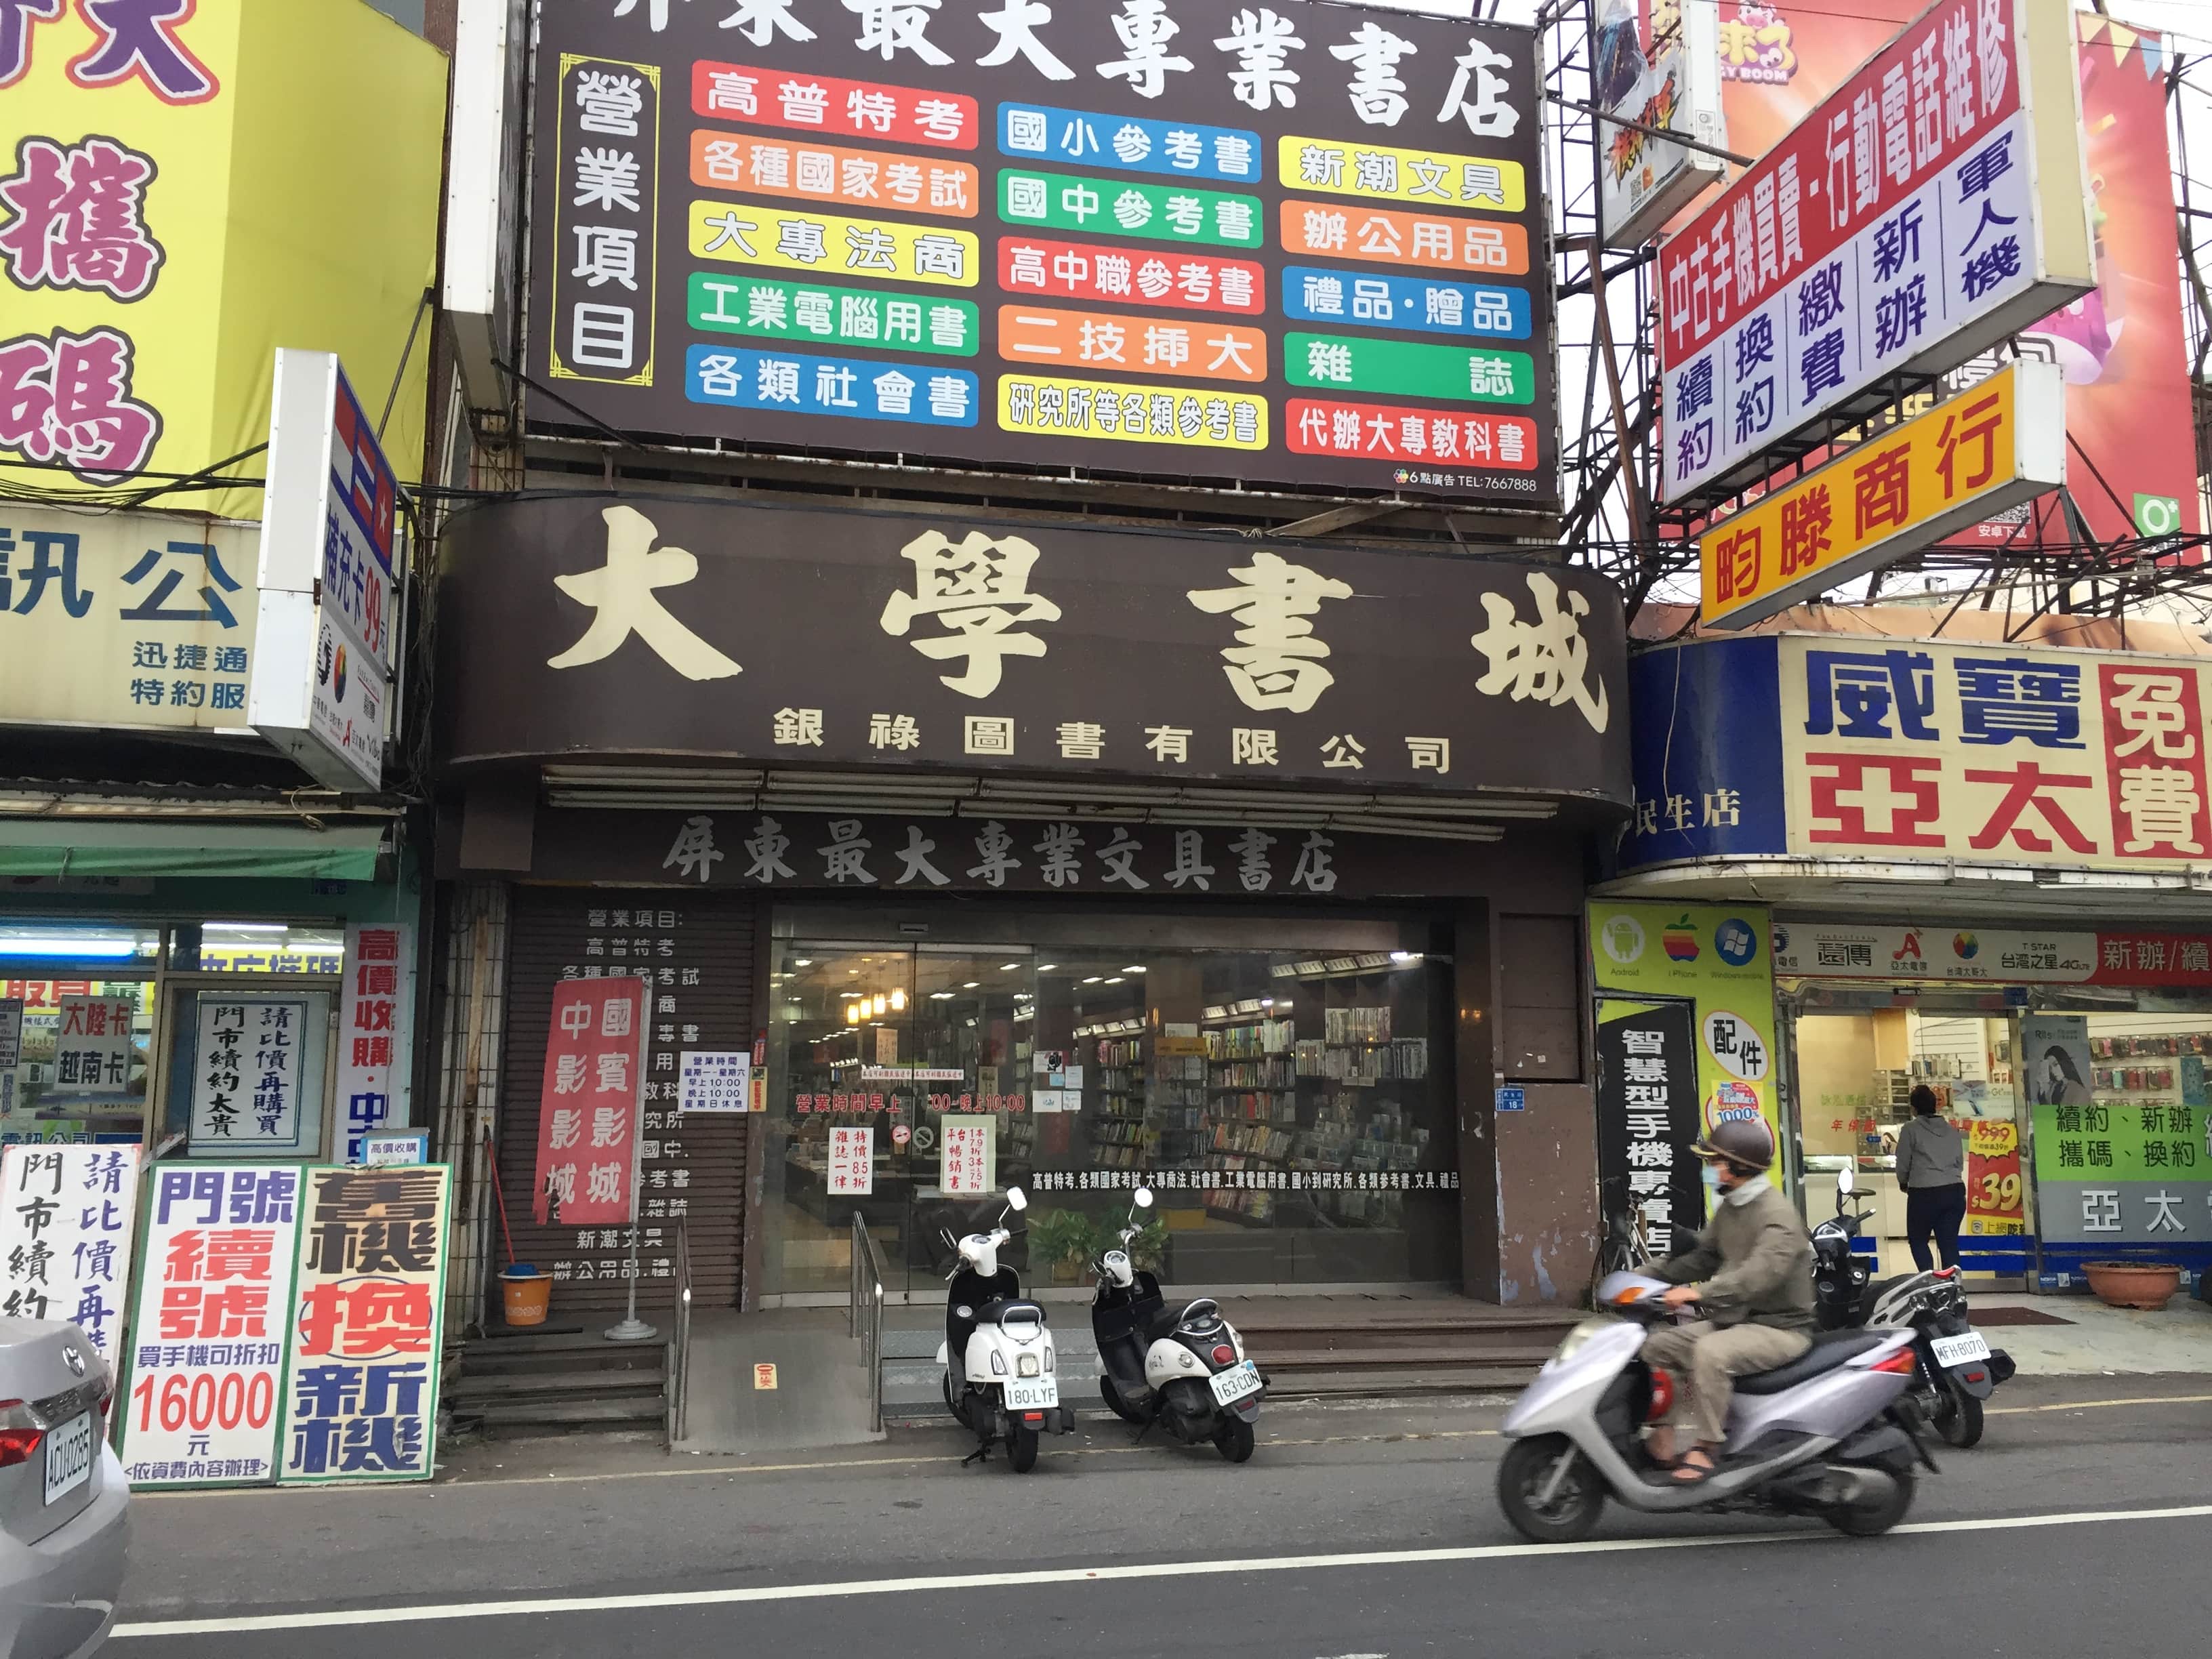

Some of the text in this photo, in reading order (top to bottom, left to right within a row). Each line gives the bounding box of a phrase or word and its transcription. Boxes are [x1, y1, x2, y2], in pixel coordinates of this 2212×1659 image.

[708, 70, 964, 141] 高普特考
[1740, 68, 1789, 82] BOOM
[1007, 109, 1253, 175] 國小參考書
[703, 140, 968, 211] 各種國家考試
[1299, 145, 1505, 204] 新潮文具
[571, 69, 643, 370] 營業項目
[1007, 178, 1254, 241] 國中參考書
[1303, 210, 1509, 268] 辦公用品
[1957, 129, 2022, 302] 軍人機
[703, 211, 965, 279] 大專法商
[1010, 245, 1254, 308] 高中職參考書
[1873, 198, 1927, 359] 新辦
[699, 281, 968, 348] 工業電腦用書
[1012, 315, 1253, 375] 二技插大
[1798, 260, 1845, 407] 繳費
[698, 354, 970, 418] 各類社會書
[1735, 312, 1774, 445] 換約
[1009, 382, 1259, 443] 研究所等各類參考書
[1298, 408, 1525, 462] 代辦大專教科書
[1676, 353, 1713, 481] 續約
[547, 505, 1609, 733] 大學書城
[134, 641, 247, 673] 迅捷通
[130, 679, 245, 710] 特約服
[1803, 649, 2086, 750] 威寶
[773, 707, 1450, 773] 銀祿圖書有限公司
[2110, 672, 2205, 853] 免費
[1635, 788, 1741, 838] 民生店
[1805, 752, 2098, 855] 亞太
[662, 815, 1338, 892] 屏東最大專業文具書店
[586, 937, 675, 956] 高普特考
[63, 1002, 130, 1036] 大陸卡
[1713, 1019, 1762, 1076] 配件
[58, 1050, 125, 1084] 越南卡
[204, 1006, 244, 1137] 門市續約太貴
[253, 1006, 293, 1136] 請比價再購買
[586, 998, 632, 1204] 國賓影城
[157, 1171, 295, 1225] 門號
[2082, 1189, 2212, 1233] 亞太
[137, 1343, 279, 1368] 買手機可折扣
[134, 1372, 274, 1431] 16000
[187, 1434, 210, 1456] 元
